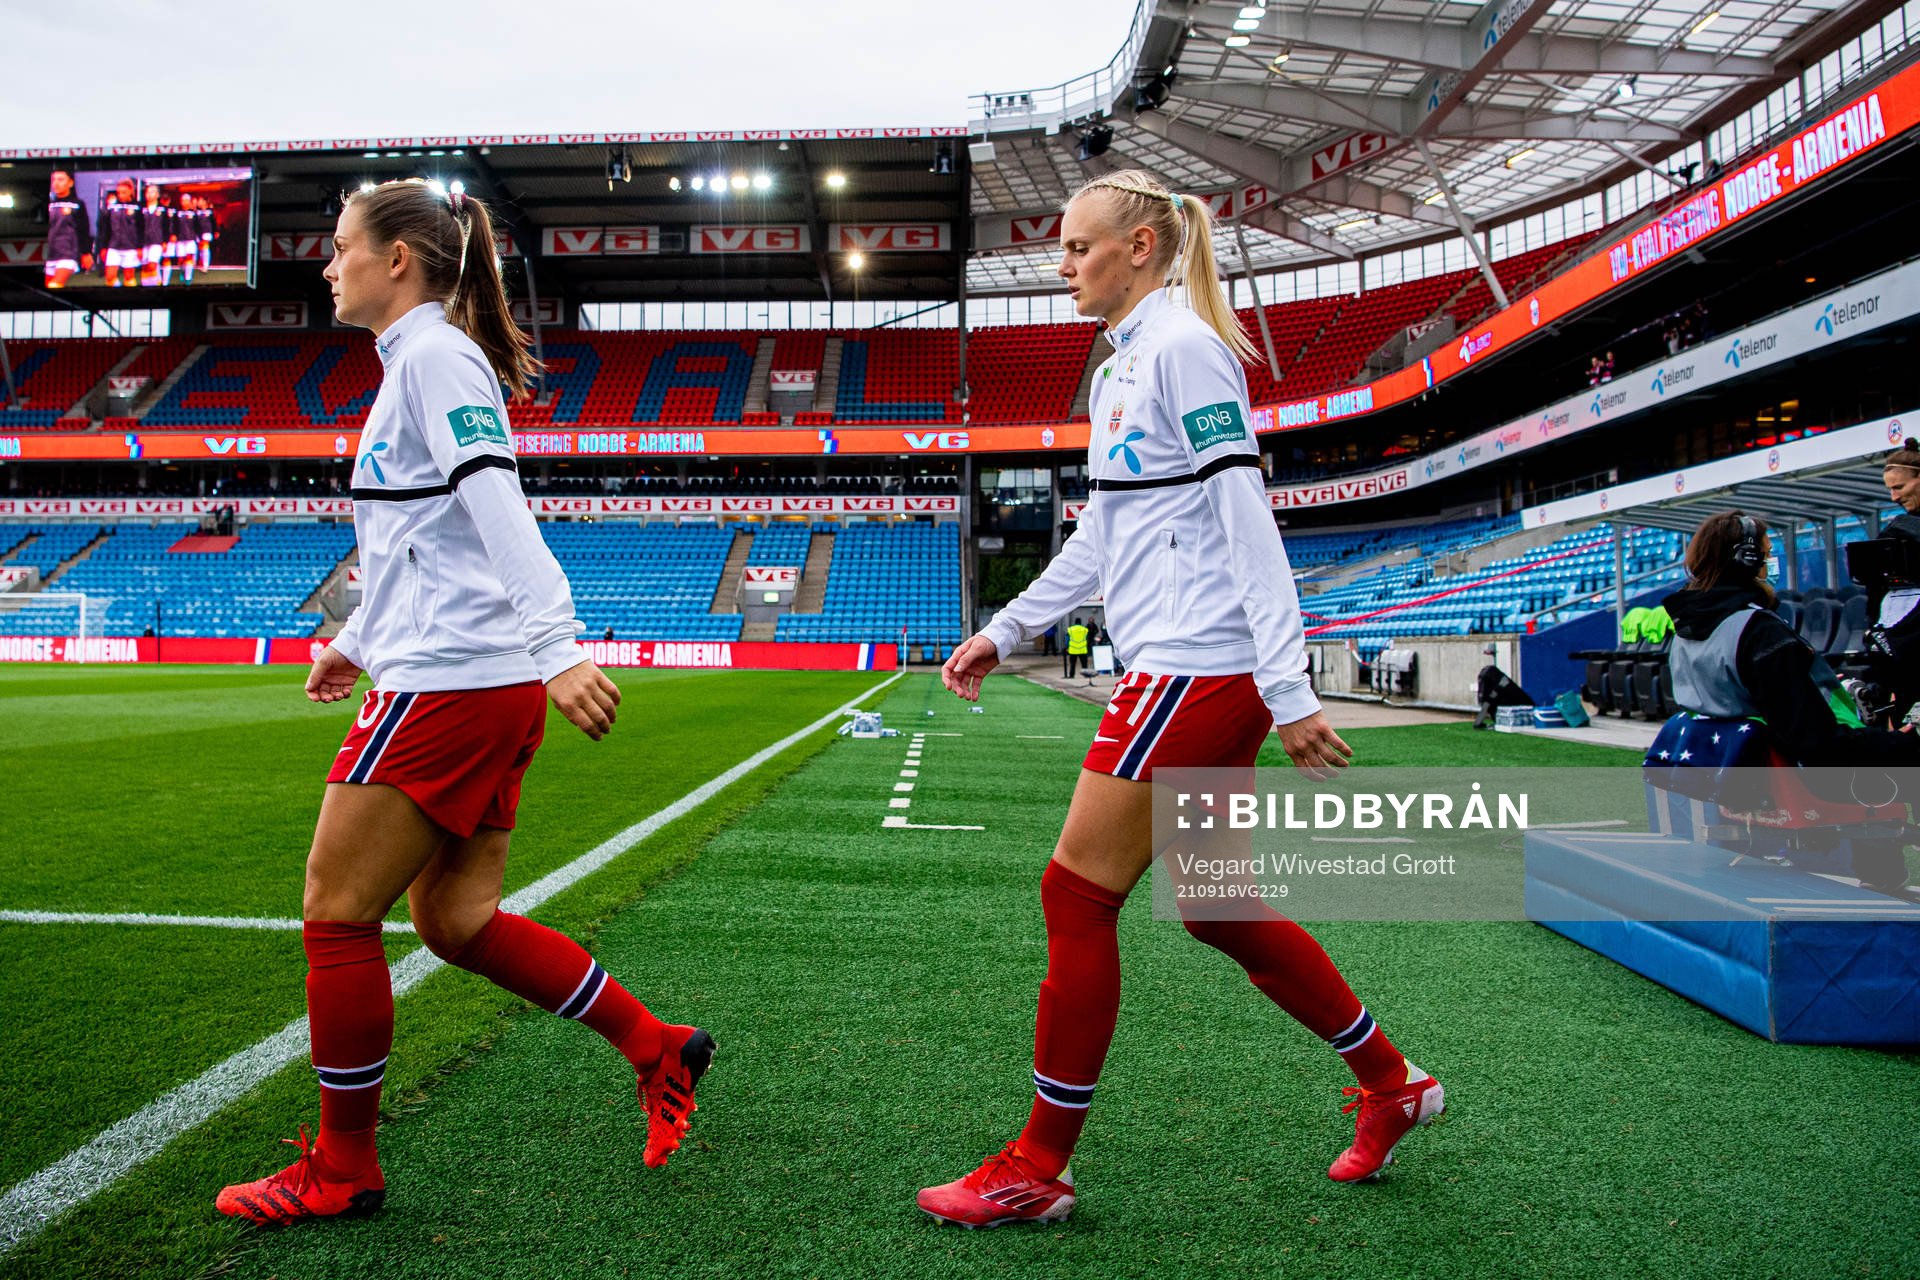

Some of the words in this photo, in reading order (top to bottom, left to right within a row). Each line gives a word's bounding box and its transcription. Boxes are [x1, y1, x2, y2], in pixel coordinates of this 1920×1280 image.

[606, 134, 639, 142] VG
[652, 132, 686, 141] VG
[698, 132, 732, 140] VG
[746, 131, 778, 140] VG
[792, 130, 825, 139] VG
[838, 129, 872, 138] VG
[885, 128, 919, 137] VG
[932, 128, 966, 136] VG
[334, 140, 366, 148] VG
[379, 138, 411, 147] VG
[424, 138, 456, 146] VG
[469, 136, 501, 145] VG
[515, 136, 547, 144] VG
[560, 134, 593, 143] VG
[158, 145, 189, 154] VG
[202, 144, 232, 153] VG
[246, 142, 277, 150] VG
[290, 141, 321, 150] VG
[1314, 135, 1383, 174] VG
[556, 231, 644, 252] VG
[703, 229, 795, 250] VG
[843, 227, 935, 248] VG
[217, 304, 298, 325] VG
[1833, 294, 1881, 326] telenor
[1739, 332, 1778, 360] telenor
[772, 371, 816, 383] VG
[1663, 363, 1695, 387] telenor
[1600, 389, 1628, 410] telenor
[462, 409, 496, 431] DNB
[1195, 406, 1232, 432] DNB
[204, 437, 266, 455] VG
[904, 432, 970, 449] VG
[1380, 471, 1405, 492] VG
[1340, 480, 1376, 499] VG
[1294, 488, 1333, 505] VG
[28, 502, 68, 513] VG
[82, 502, 124, 513] VG
[138, 502, 181, 513] VG
[251, 501, 296, 513] VG
[309, 501, 353, 513] VG
[544, 499, 589, 511] VG
[604, 499, 650, 511] VG
[664, 499, 709, 511] VG
[725, 498, 770, 510] VG
[785, 498, 831, 510] VG
[846, 498, 892, 510] VG
[907, 498, 953, 510] VG
[748, 567, 797, 582] VG
